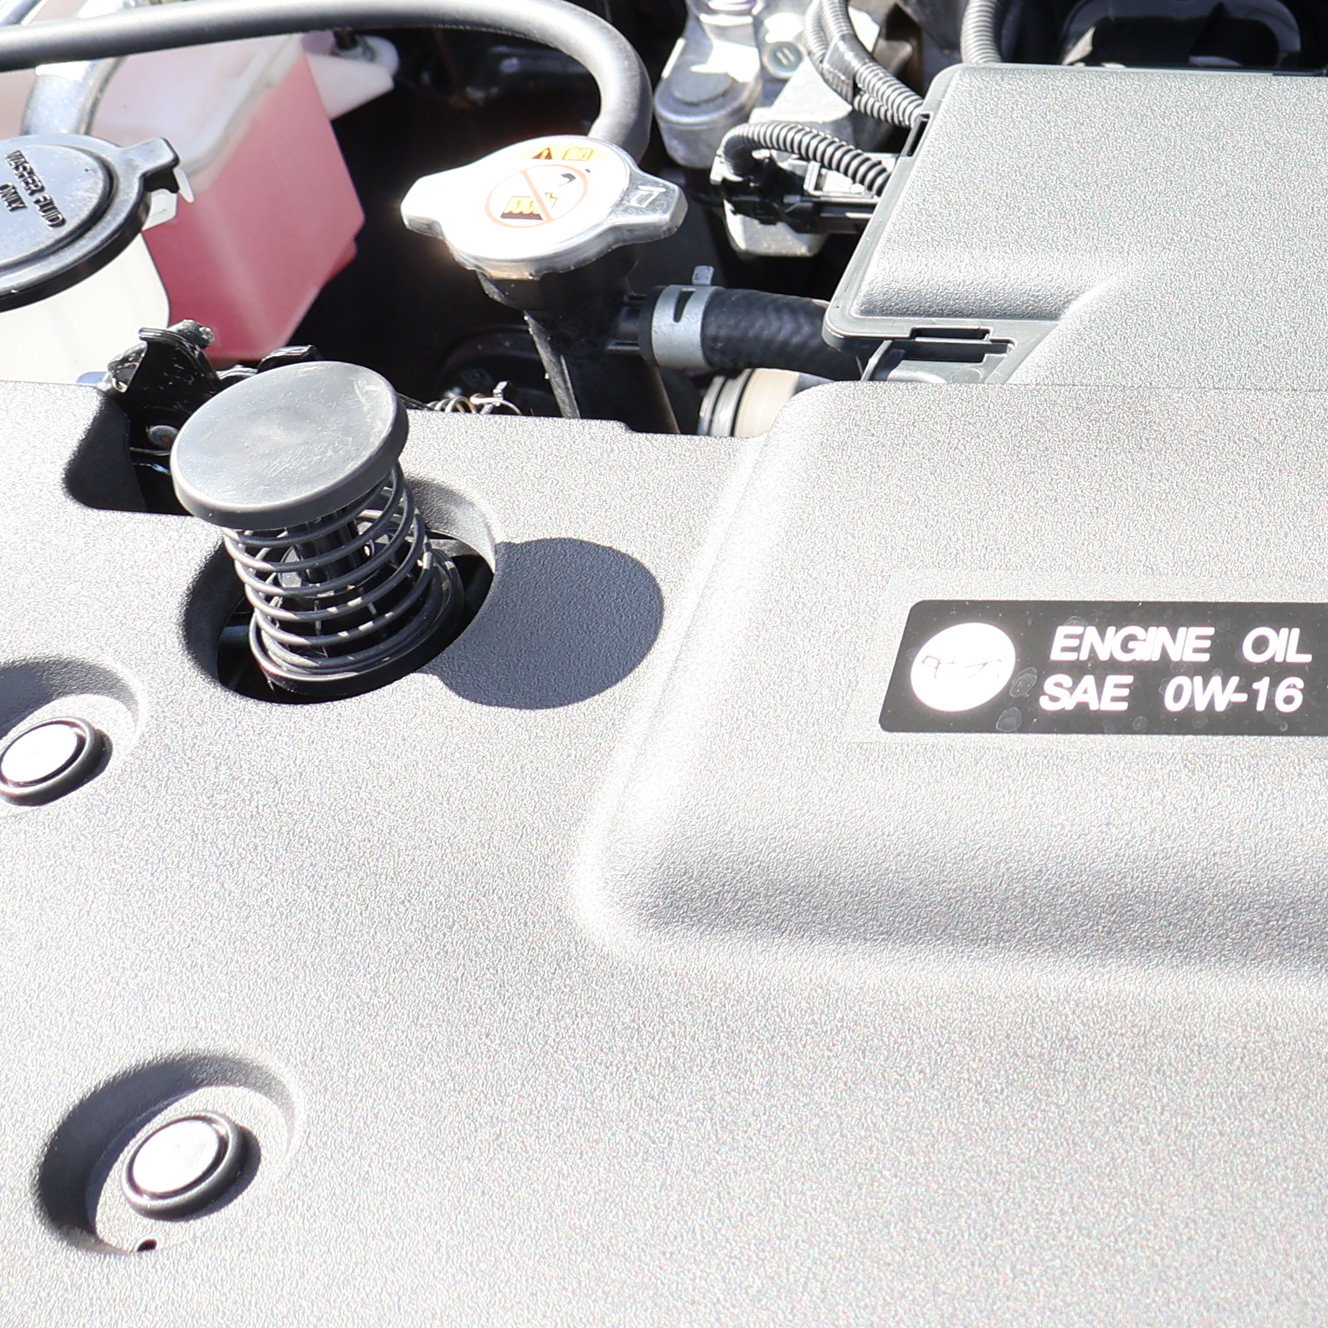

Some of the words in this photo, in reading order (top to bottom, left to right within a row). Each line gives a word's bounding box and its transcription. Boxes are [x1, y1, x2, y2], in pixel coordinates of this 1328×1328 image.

[4, 149, 45, 197] WASHER
[32, 193, 67, 228] FLUID
[1048, 624, 1217, 664] ENGINE
[1240, 626, 1314, 665] OIL
[1037, 673, 1134, 713] SAE
[1162, 674, 1306, 714] 0W-16
